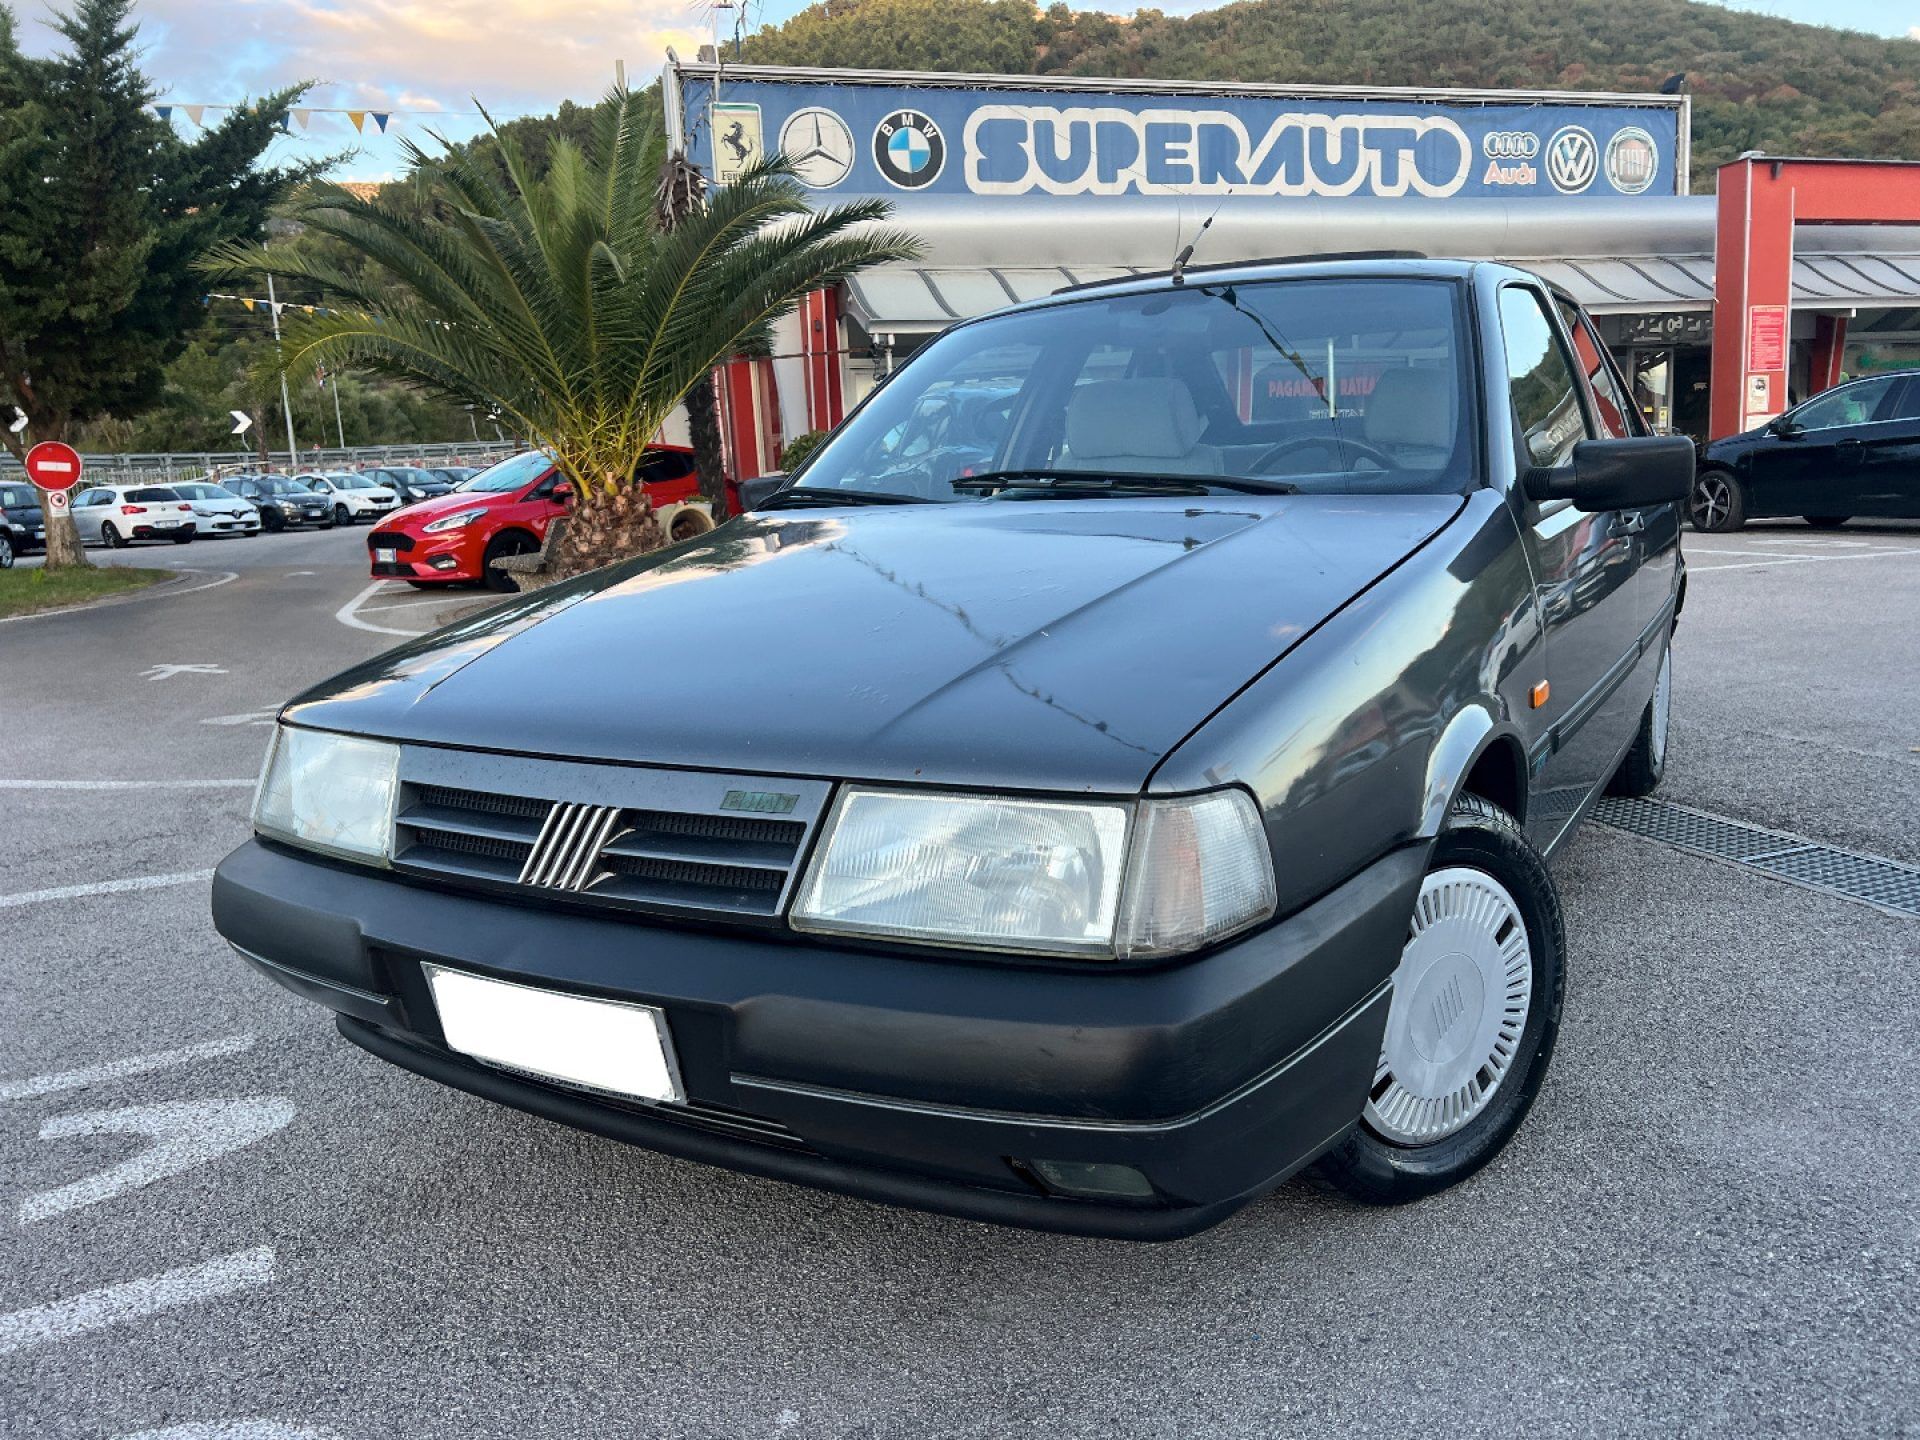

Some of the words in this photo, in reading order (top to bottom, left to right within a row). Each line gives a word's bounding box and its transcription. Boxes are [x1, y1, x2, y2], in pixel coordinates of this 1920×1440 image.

[880, 112, 937, 138] BMW
[965, 106, 1472, 196] SUPERAUTO
[1618, 148, 1650, 177] FIAT
[1483, 160, 1537, 185] Audi
